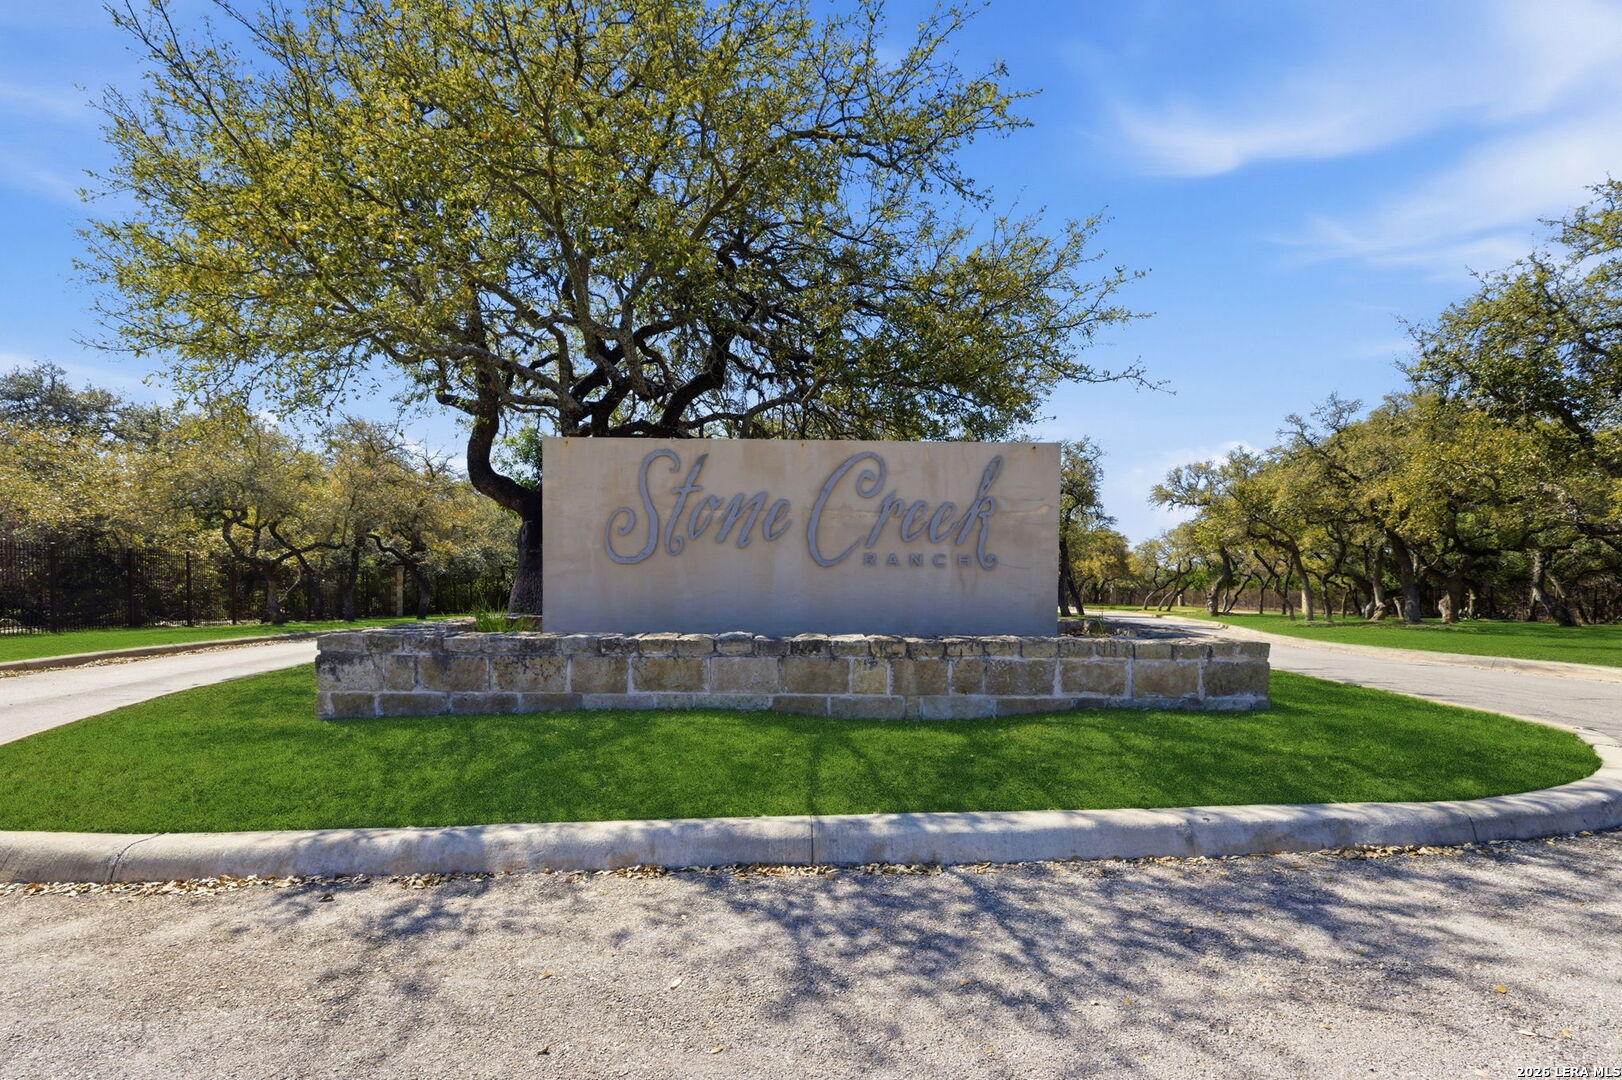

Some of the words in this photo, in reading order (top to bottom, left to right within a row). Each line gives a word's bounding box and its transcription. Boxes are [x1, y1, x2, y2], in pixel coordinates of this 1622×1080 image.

[605, 448, 793, 564] Stone
[807, 451, 1004, 570] Creek
[862, 552, 972, 568] RANCH
